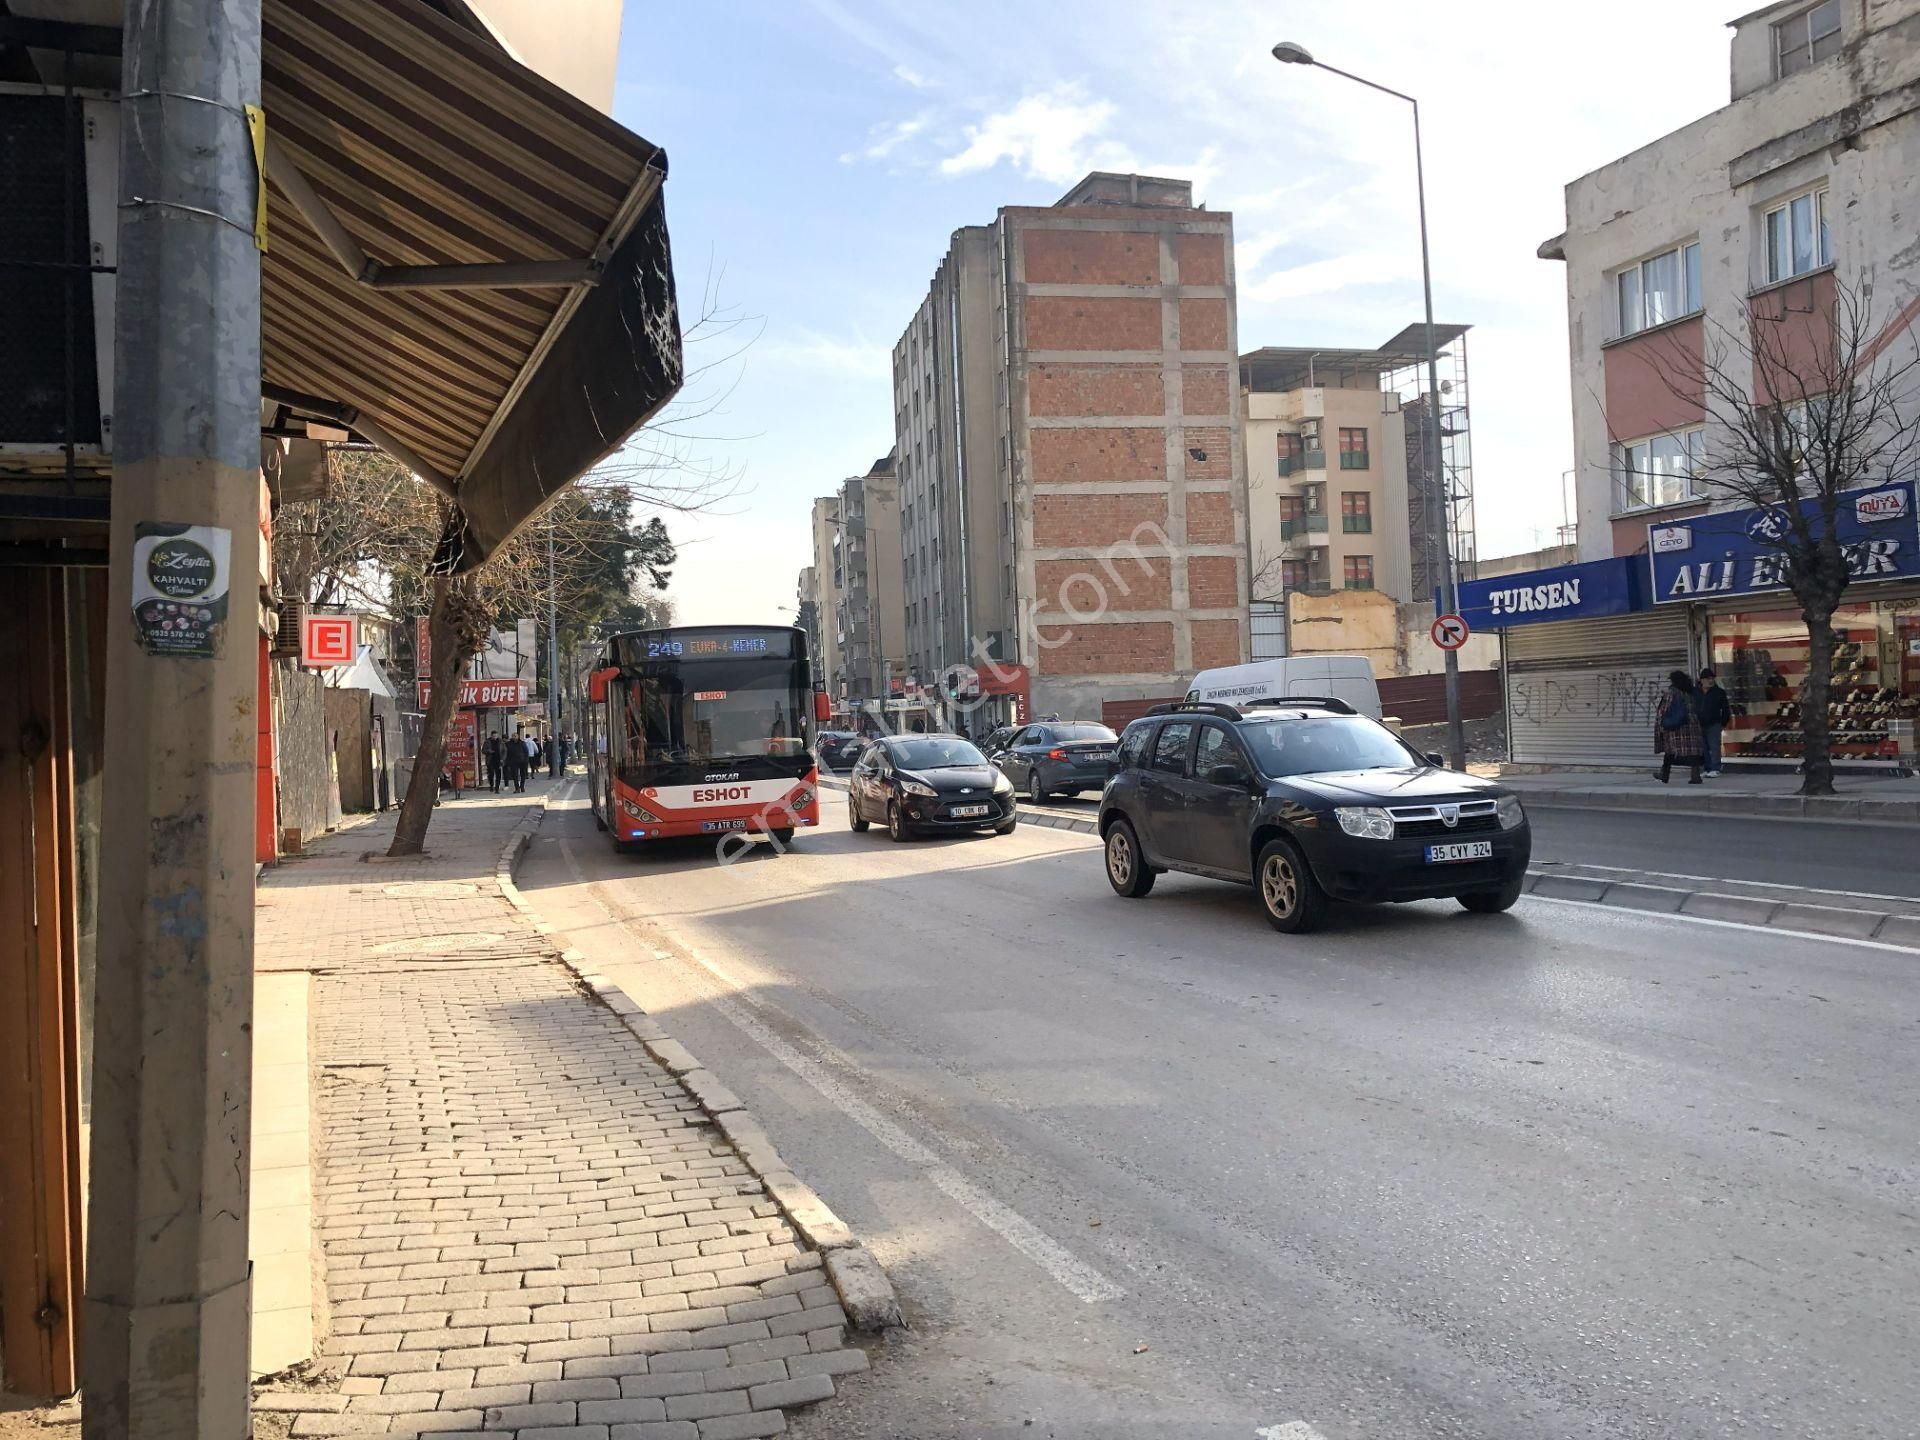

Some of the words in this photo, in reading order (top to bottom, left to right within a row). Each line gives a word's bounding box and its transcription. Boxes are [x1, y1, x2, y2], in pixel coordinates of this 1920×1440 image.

[153, 575, 207, 587] KAHVALTI
[1669, 551, 1735, 595] ALİ
[1489, 578, 1581, 615] TURSEN
[318, 626, 342, 654] E
[648, 641, 683, 657] 249
[482, 682, 515, 703] BÜFE
[705, 772, 739, 781] OTOKAR
[693, 786, 751, 802] ESHOT
[955, 807, 962, 815] 10
[717, 821, 731, 830] ATR
[732, 820, 745, 828] 699
[1433, 846, 1445, 860] 35
[1450, 845, 1468, 858] CVY
[1473, 843, 1490, 856] 324
